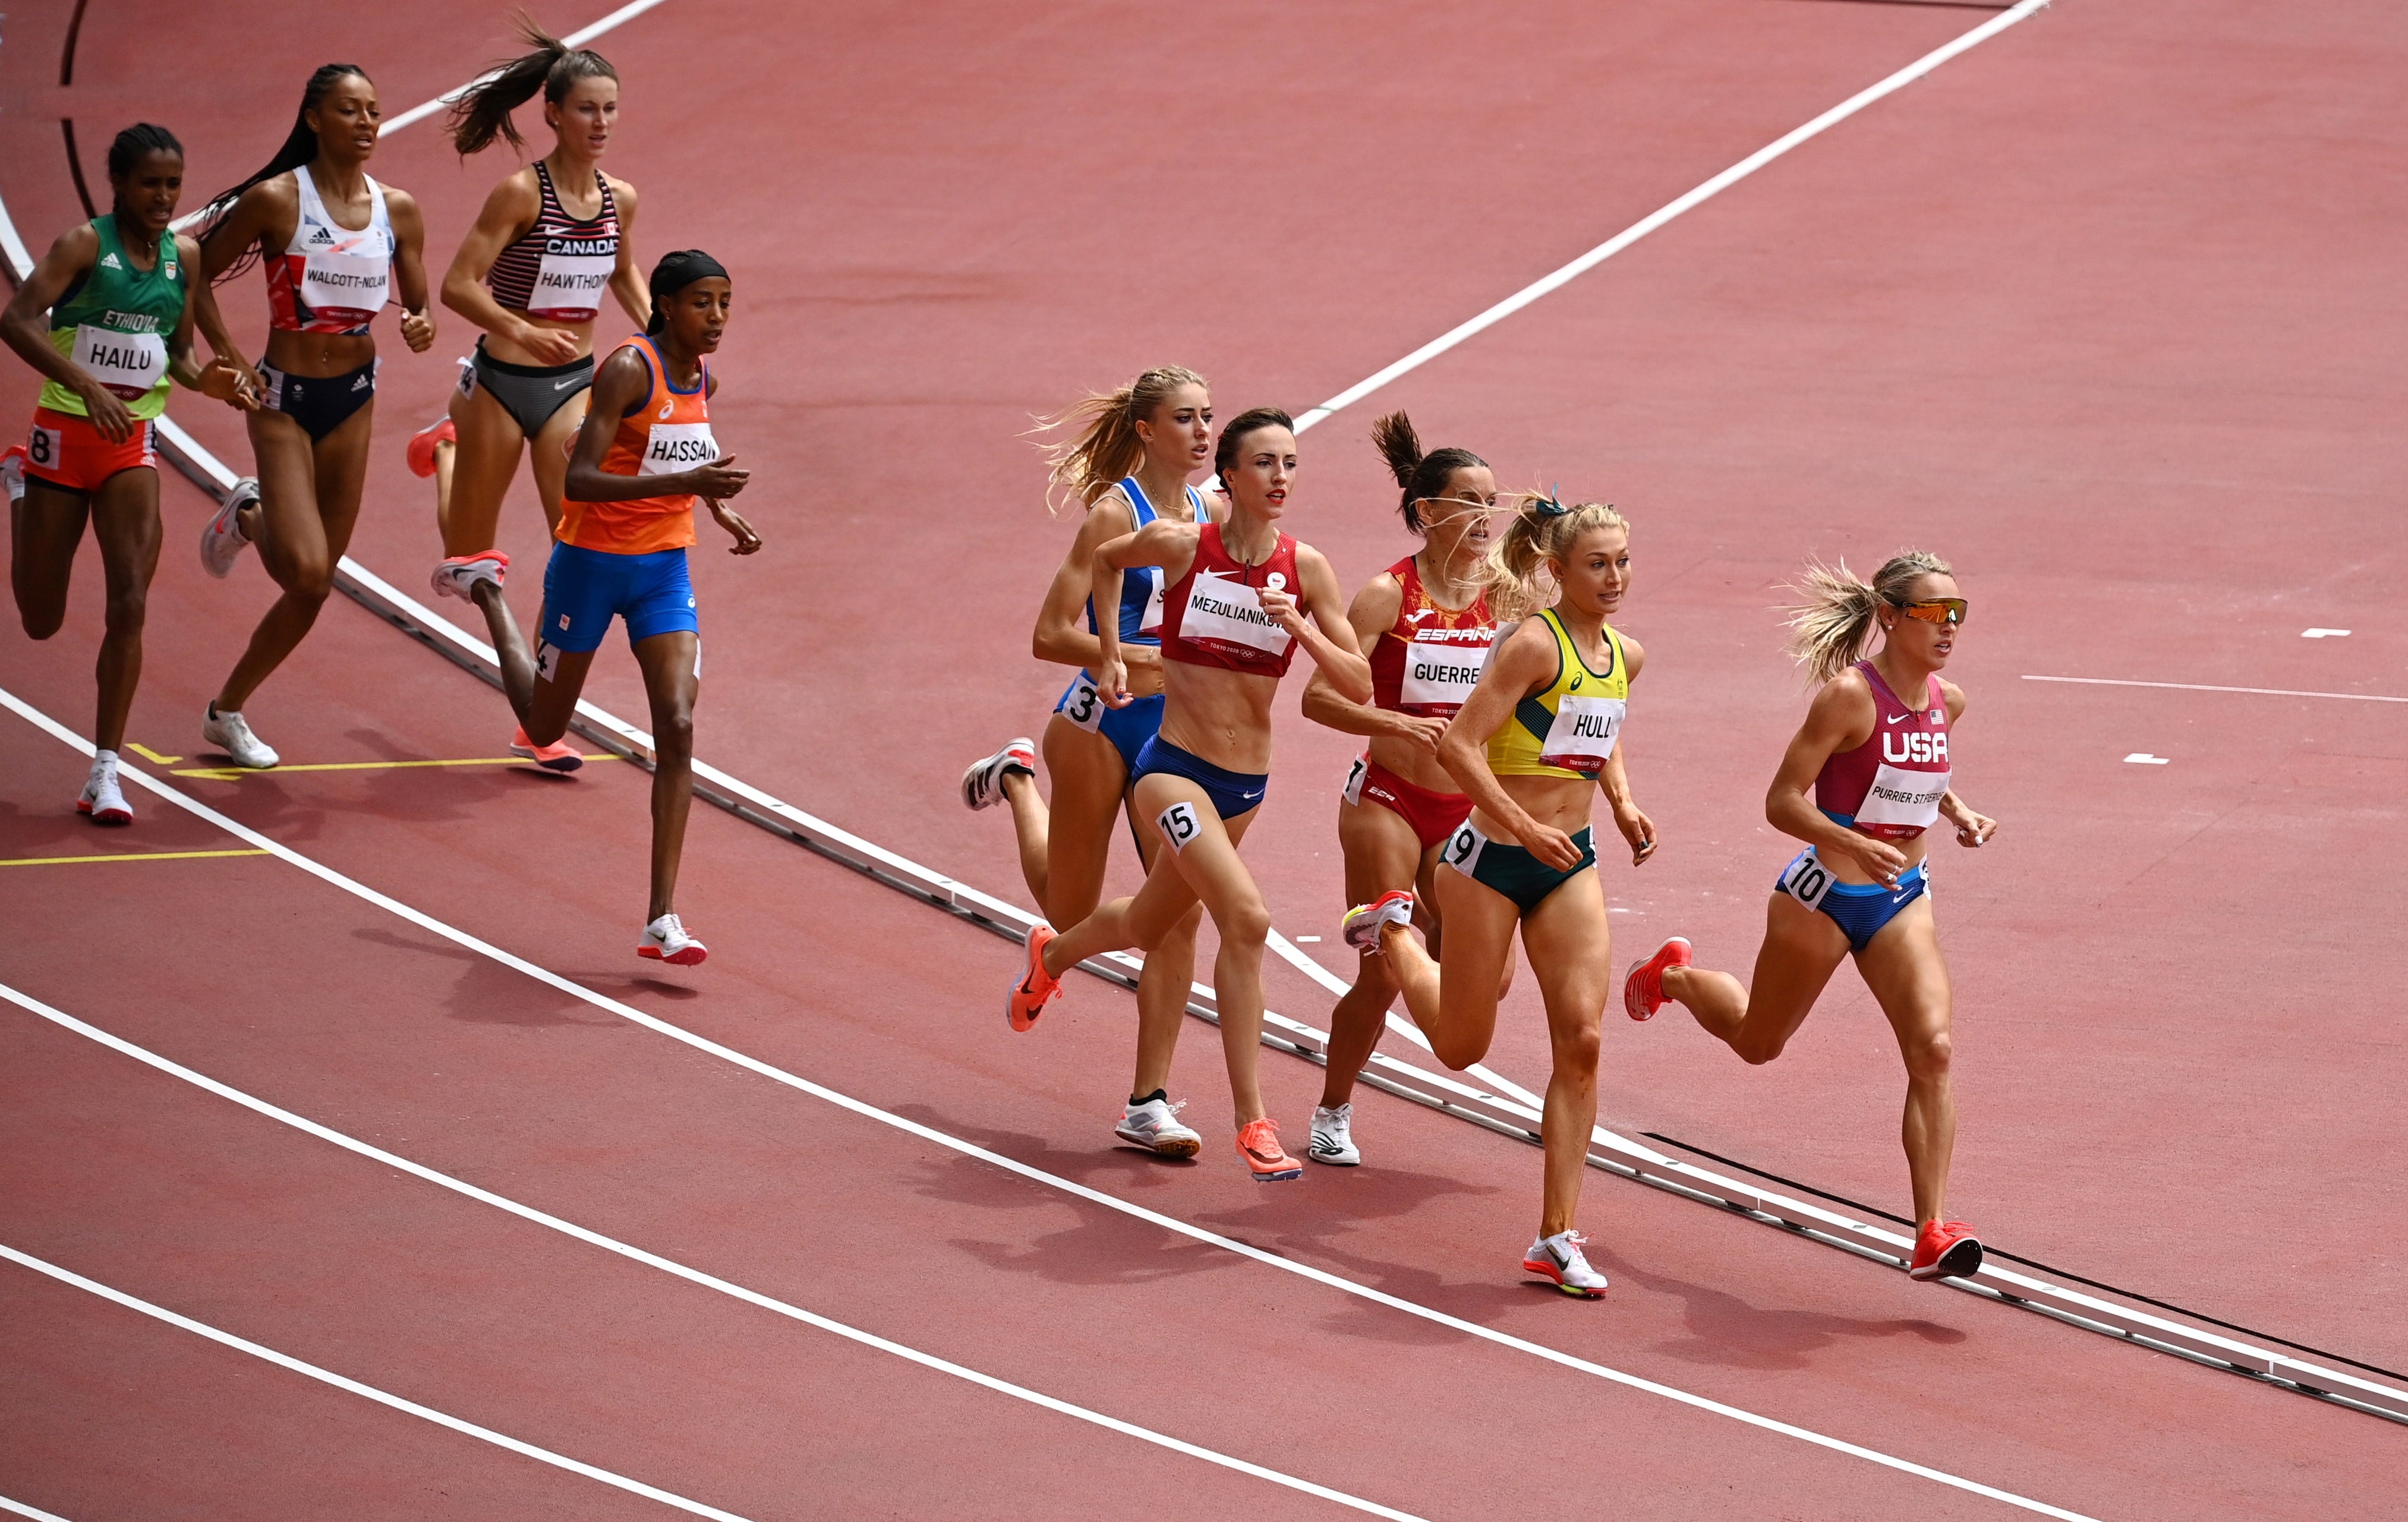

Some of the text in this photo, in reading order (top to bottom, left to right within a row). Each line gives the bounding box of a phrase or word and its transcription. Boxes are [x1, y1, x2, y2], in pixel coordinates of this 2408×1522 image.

[547, 239, 615, 254] CANADA
[307, 269, 386, 288] WALCOTT-NOLAN
[102, 310, 160, 332] ETHIOIA
[90, 343, 151, 370] HAILU
[31, 430, 50, 463] 8
[651, 440, 716, 461] HASSAN
[1191, 595, 1283, 628] MEZULIANIKO
[537, 640, 548, 673] 4
[1210, 642, 1226, 651] TOKYO
[1414, 664, 1480, 684] GUERRE
[1070, 686, 1097, 723] 3
[1572, 714, 1611, 738] HULL
[1883, 732, 1949, 762] USA
[1345, 760, 1363, 793] 7
[1872, 786, 1912, 803] PURRIER
[1161, 806, 1193, 847] 15
[1455, 828, 1476, 865] 9
[1789, 858, 1826, 903] 10
